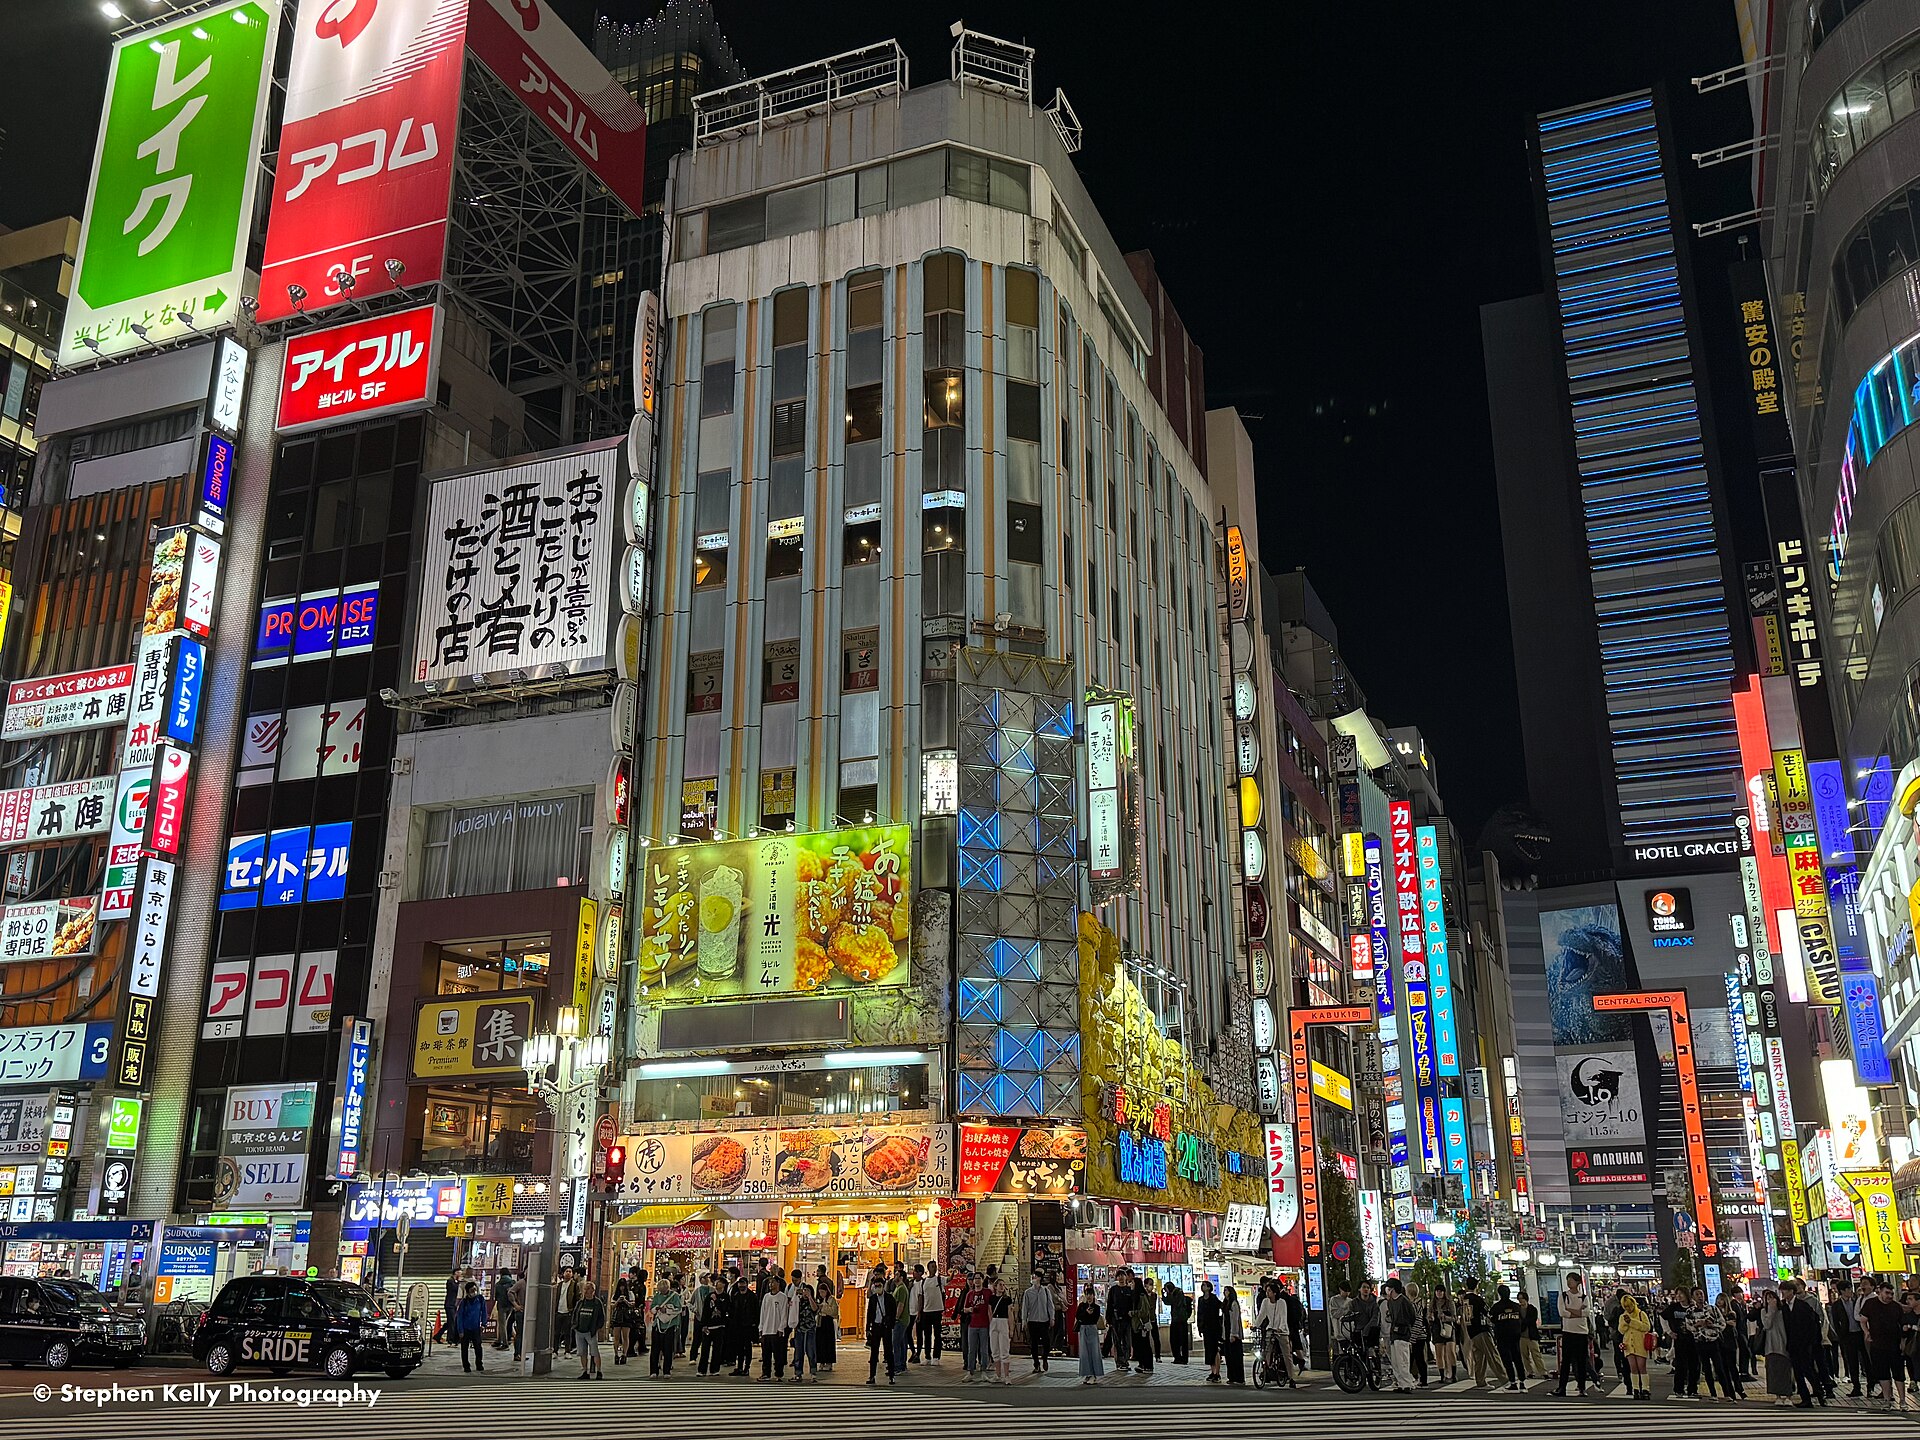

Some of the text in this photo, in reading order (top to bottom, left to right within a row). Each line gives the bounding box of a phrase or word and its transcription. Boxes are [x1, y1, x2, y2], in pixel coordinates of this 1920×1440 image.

[520, 52, 599, 161] アコム
[123, 40, 212, 257] レイク
[286, 117, 438, 203] アコム
[324, 254, 374, 296] 3F
[73, 299, 197, 351] 当ビルとなり
[291, 330, 424, 391] アイフル
[1740, 299, 1779, 415] 驚安の殿堂
[223, 350, 239, 417] 戸谷ビル
[318, 382, 386, 409] 当ビル 5F
[209, 444, 227, 501] PROMISE
[205, 517, 217, 528] 6F
[530, 496, 567, 649] こだわりの
[430, 519, 485, 667] だけの店
[190, 619, 201, 632] 5F
[265, 597, 374, 637] PROMISE
[1778, 540, 1822, 687] ドン・キホーテ
[1765, 618, 1782, 662] Garam
[137, 649, 162, 713] 専門店
[176, 652, 198, 728] セントラル
[82, 692, 127, 720] 本陣
[1783, 754, 1800, 798] 生ビール
[37, 795, 105, 836] 本陣
[159, 787, 179, 836] アコム
[157, 838, 172, 849] 3F
[1736, 815, 1752, 850] Booth
[1793, 834, 1815, 846] 4F
[228, 846, 348, 888] セントラル
[1099, 844, 1110, 858] 光
[1635, 846, 1682, 861] HOTEL
[829, 846, 850, 909] チキンが
[1392, 807, 1422, 954] カラオケ歌広場
[1794, 851, 1824, 896] 麻雀
[279, 890, 294, 902] 4F
[612, 891, 621, 900] 1F
[808, 878, 828, 934] たべたい。
[852, 871, 878, 935] 猛烈に
[1746, 861, 1758, 902] ネットカフェ
[1753, 916, 1764, 944] カプセル
[7, 918, 48, 938] 粉もの
[652, 863, 673, 989] レモンサワー
[763, 913, 781, 937] 光
[1653, 917, 1675, 925] TOHO
[1653, 923, 1685, 931] CINEMAS
[5, 936, 46, 956] 専門店
[1653, 937, 1694, 948] IMAX
[760, 960, 780, 969] 当ビル
[760, 970, 780, 988] 4F
[209, 965, 334, 1015] アコム
[1410, 991, 1426, 1006] 薬
[1597, 995, 1671, 1006] CENTRAL ROAD
[1728, 977, 1742, 1011] 747
[131, 1002, 147, 1035] 買取
[1761, 991, 1777, 1028] Booth
[1864, 1012, 1878, 1041] IDOL
[214, 1023, 232, 1036] 3F
[420, 1038, 469, 1052] 珈琲茶館
[476, 1008, 523, 1062] 集
[1854, 1013, 1870, 1049] STAGE
[91, 1037, 110, 1064] 3
[125, 1047, 140, 1081] 販売
[1412, 1011, 1432, 1086] マツモトキヨシ
[232, 1099, 279, 1122] BUY
[344, 1048, 367, 1149] じゃんぱら
[1424, 1098, 1433, 1116] Shop
[16, 1142, 41, 1152] 190
[751, 1135, 760, 1156] そば
[964, 1133, 1010, 1144] お好み焼き
[1293, 1043, 1317, 1221] GODZILLA ROAD
[1589, 1126, 1608, 1136] 11.3
[761, 1133, 772, 1177] かき揚げ
[839, 1132, 848, 1175] ラーメン
[850, 1131, 860, 1176] とんこつ
[934, 1126, 948, 1172] かつ丼
[963, 1161, 1000, 1171] 焼きそば
[964, 1147, 1010, 1158] もんじゃ焼き
[1072, 1161, 1082, 1169] 2F
[1268, 1130, 1285, 1194] トラノコ
[1593, 1152, 1644, 1166] MARUHAN
[243, 1162, 300, 1185] SELL
[1852, 1176, 1890, 1186] カラオケ
[490, 1182, 510, 1210] 集
[166, 1229, 202, 1238] SUBNADE
[1876, 1210, 1893, 1264] 持込OK!
[163, 1246, 211, 1256] SUBNADE
[157, 1281, 167, 1297] 5
[241, 1337, 309, 1363] S.RIDE
